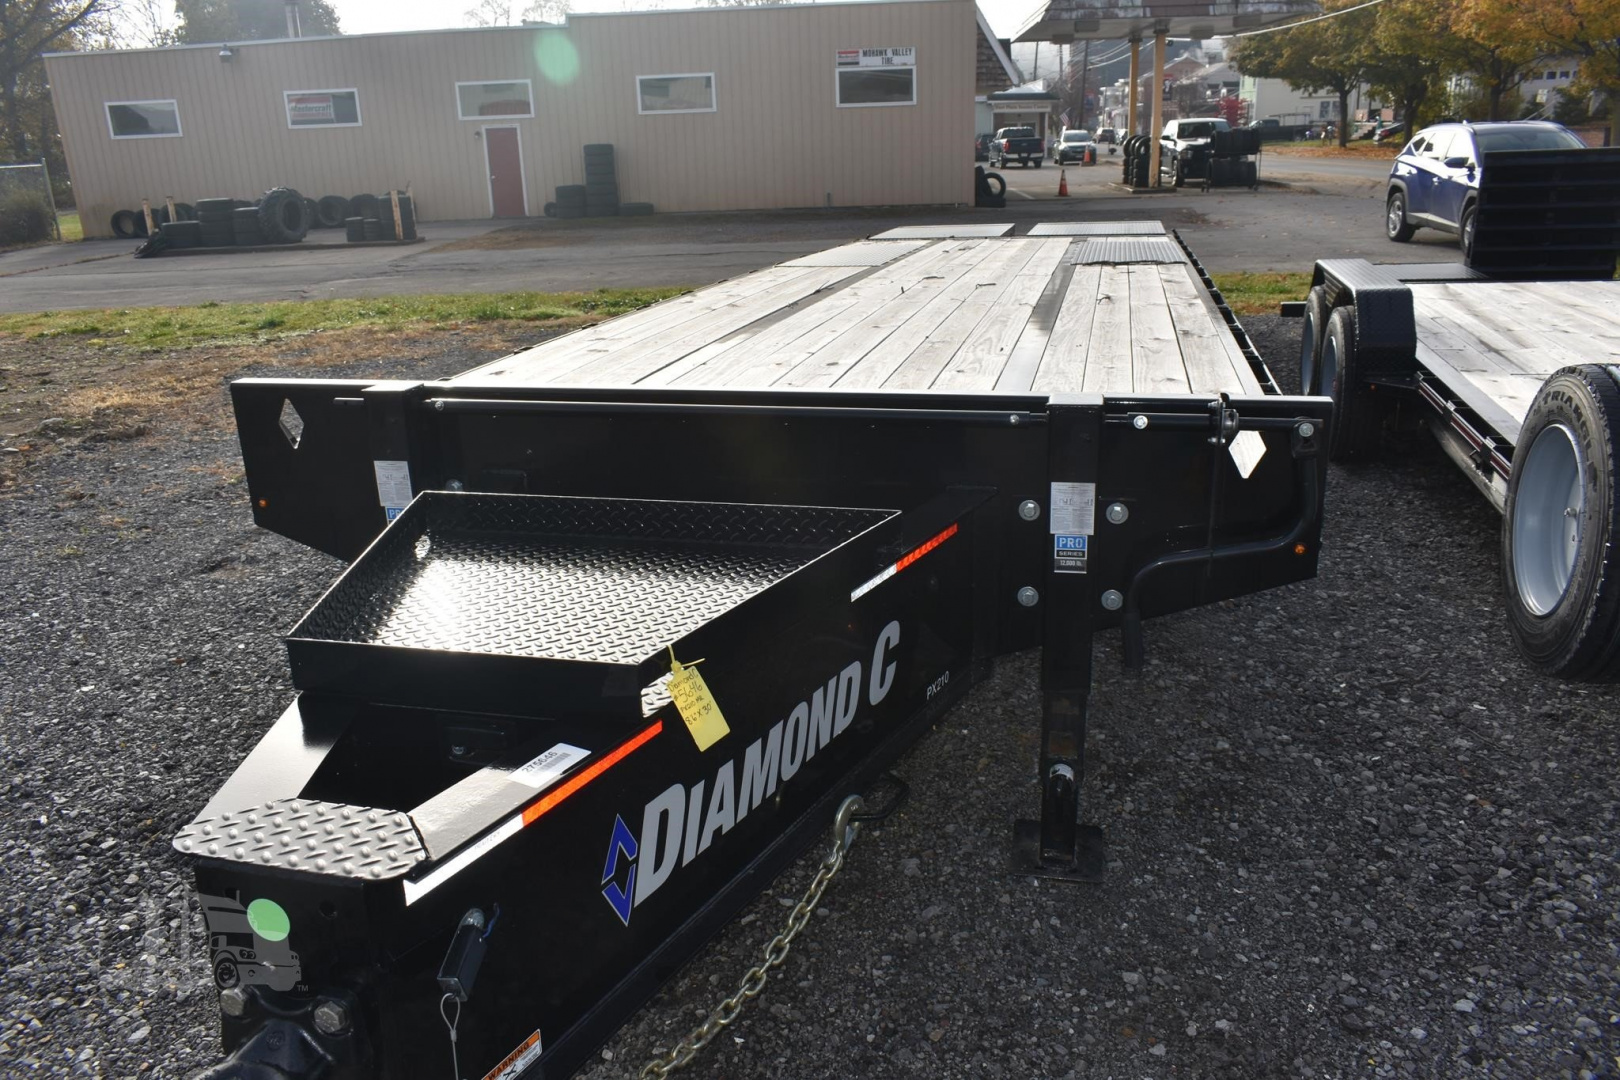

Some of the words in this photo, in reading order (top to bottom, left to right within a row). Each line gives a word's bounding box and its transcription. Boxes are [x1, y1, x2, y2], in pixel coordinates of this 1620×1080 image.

[863, 49, 888, 57] MOHAWK
[892, 48, 912, 56] VALLEY
[882, 57, 894, 65] TIRE
[1059, 537, 1083, 549] PRO
[926, 670, 950, 700] PX210
[633, 660, 861, 908] DIAMOND
[869, 620, 900, 706] C
[488, 1042, 530, 1080] WARNING
